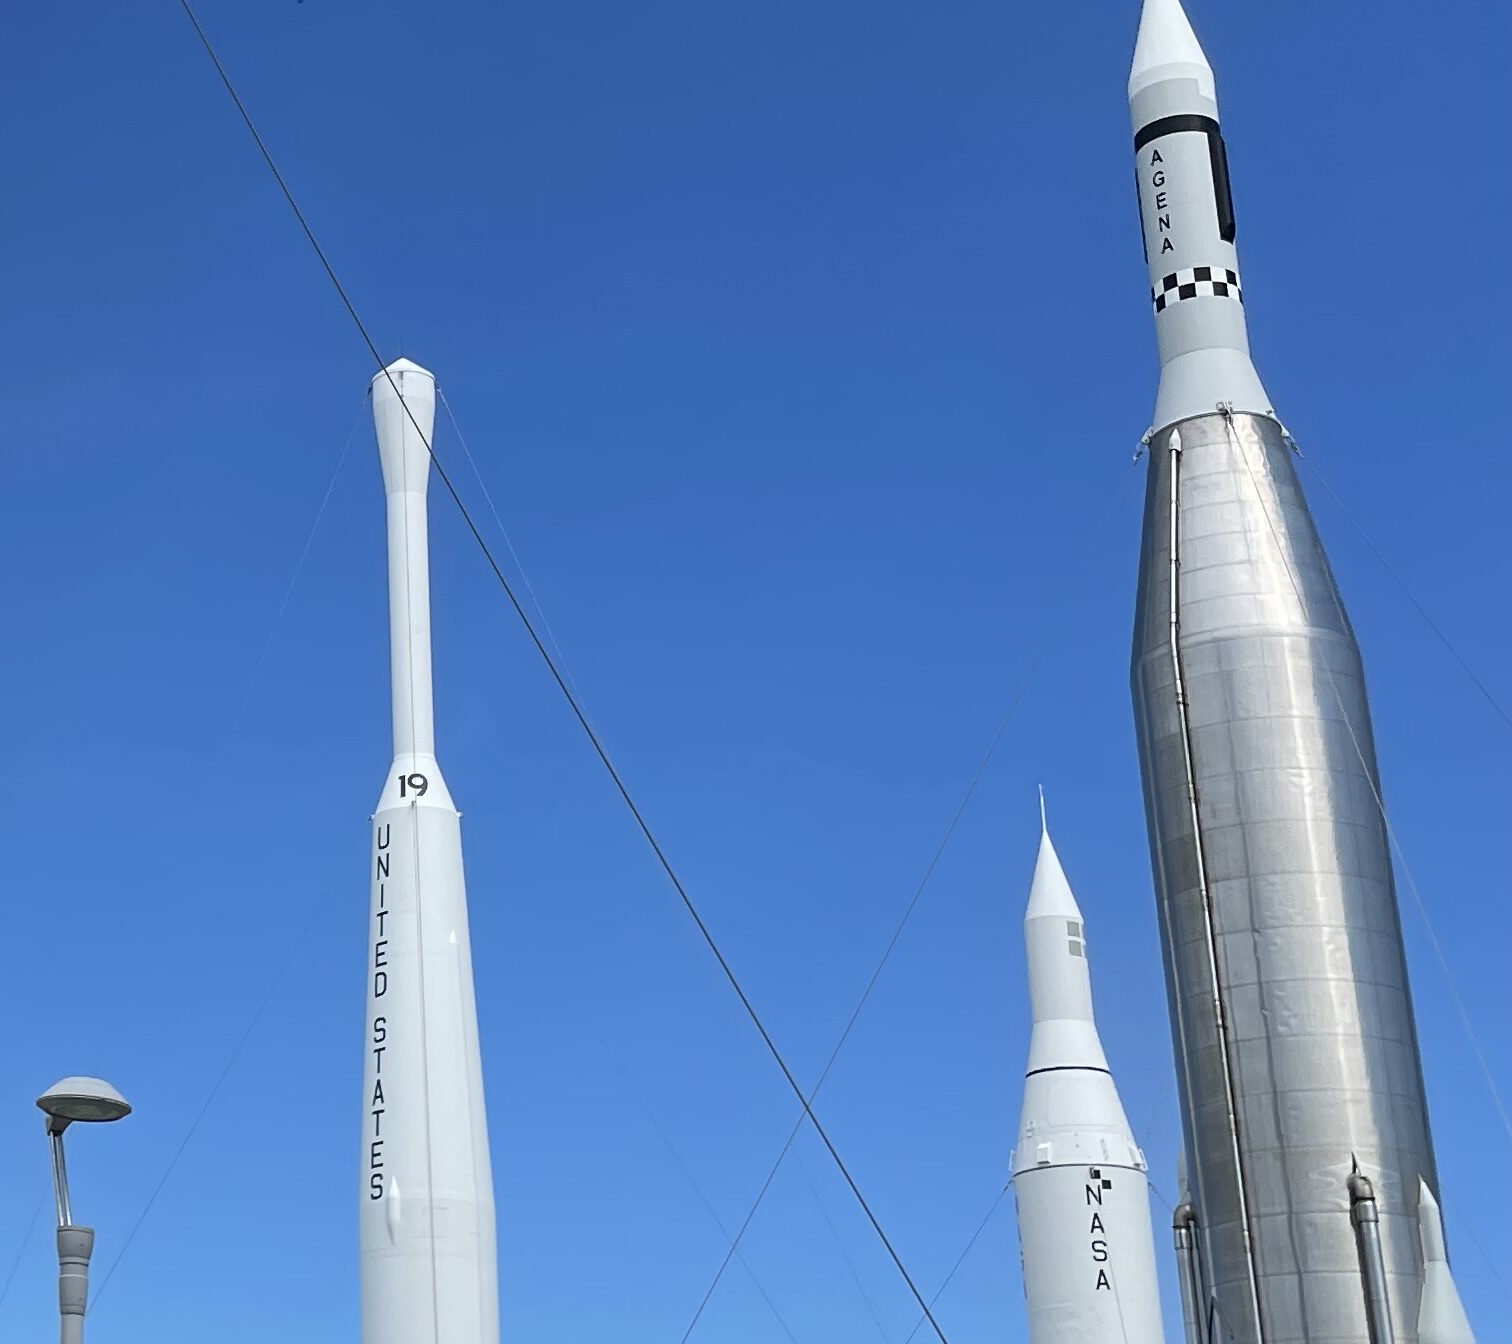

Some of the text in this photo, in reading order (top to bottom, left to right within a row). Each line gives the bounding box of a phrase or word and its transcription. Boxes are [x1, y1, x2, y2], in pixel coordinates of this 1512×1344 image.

[1150, 149, 1174, 254] AGENA
[398, 773, 429, 797] 19
[370, 824, 390, 1201] UNITED STATES
[1085, 1184, 1111, 1290] NASA
